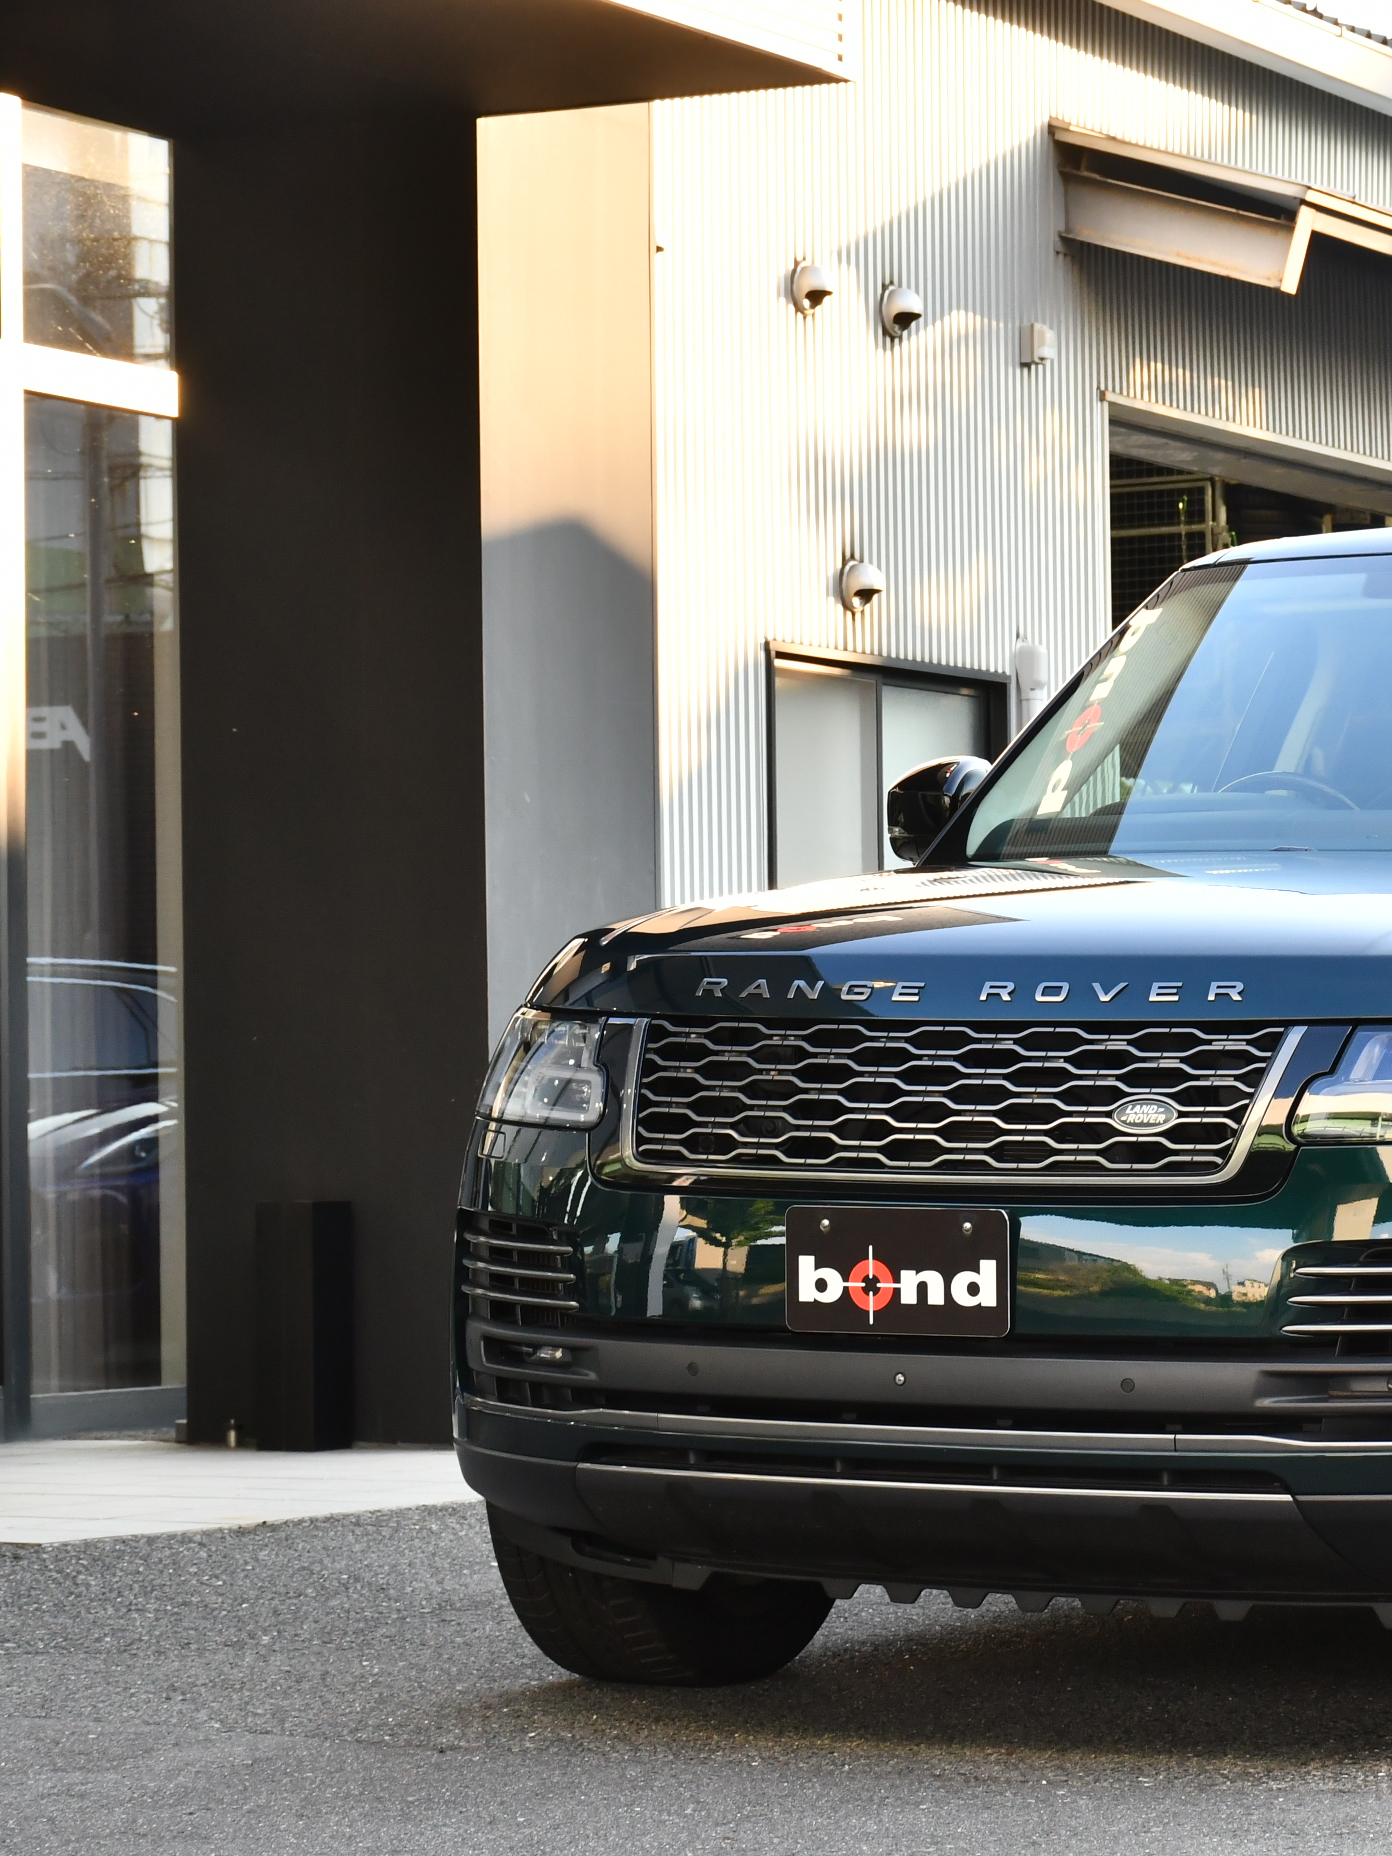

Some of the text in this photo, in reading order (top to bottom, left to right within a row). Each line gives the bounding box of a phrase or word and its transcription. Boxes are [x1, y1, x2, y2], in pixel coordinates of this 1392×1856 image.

[695, 977, 1244, 1003] RANGE ROVER
[1125, 1104, 1158, 1114] LAND
[1126, 1113, 1166, 1124] ROVER
[798, 1254, 997, 1312] bond
